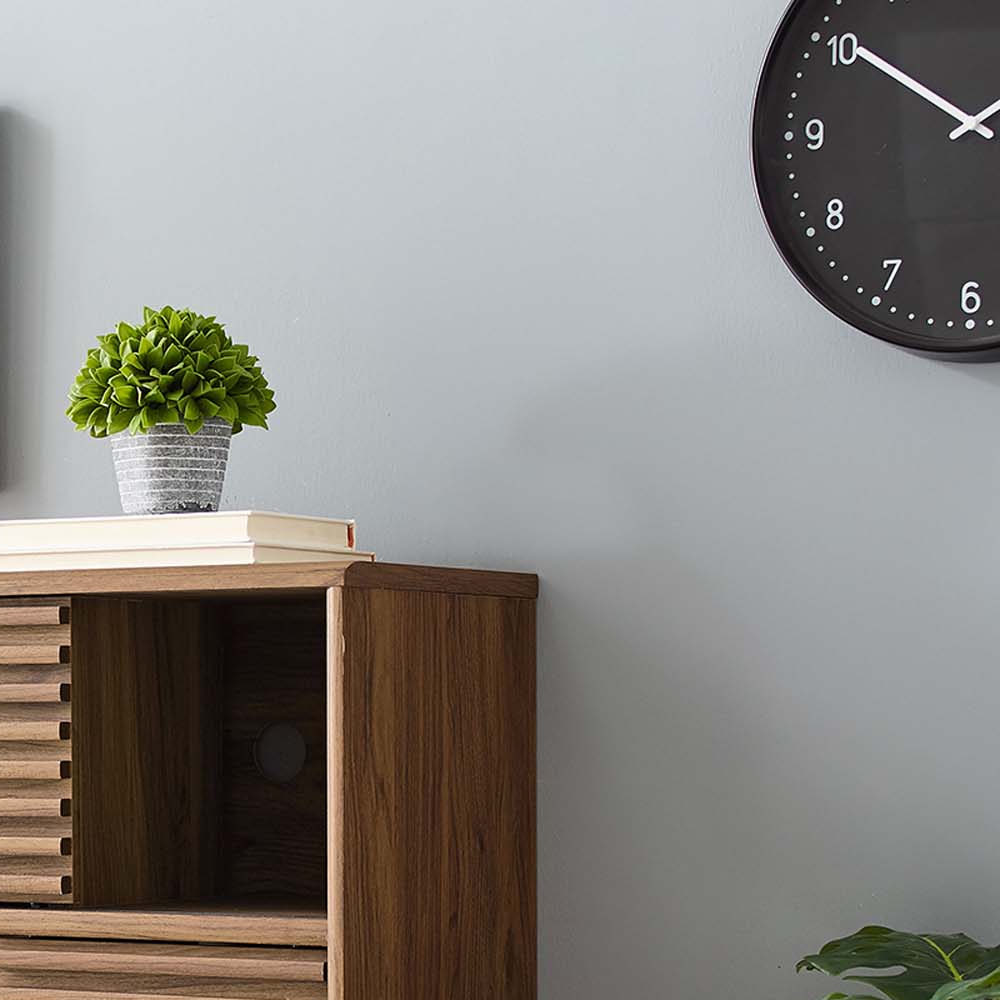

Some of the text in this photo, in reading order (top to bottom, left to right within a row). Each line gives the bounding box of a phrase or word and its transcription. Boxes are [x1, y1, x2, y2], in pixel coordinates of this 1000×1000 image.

[826, 32, 858, 66] 10
[805, 118, 825, 150] 9
[825, 198, 844, 230] 8
[882, 259, 902, 291] 7
[960, 281, 981, 314] 6
